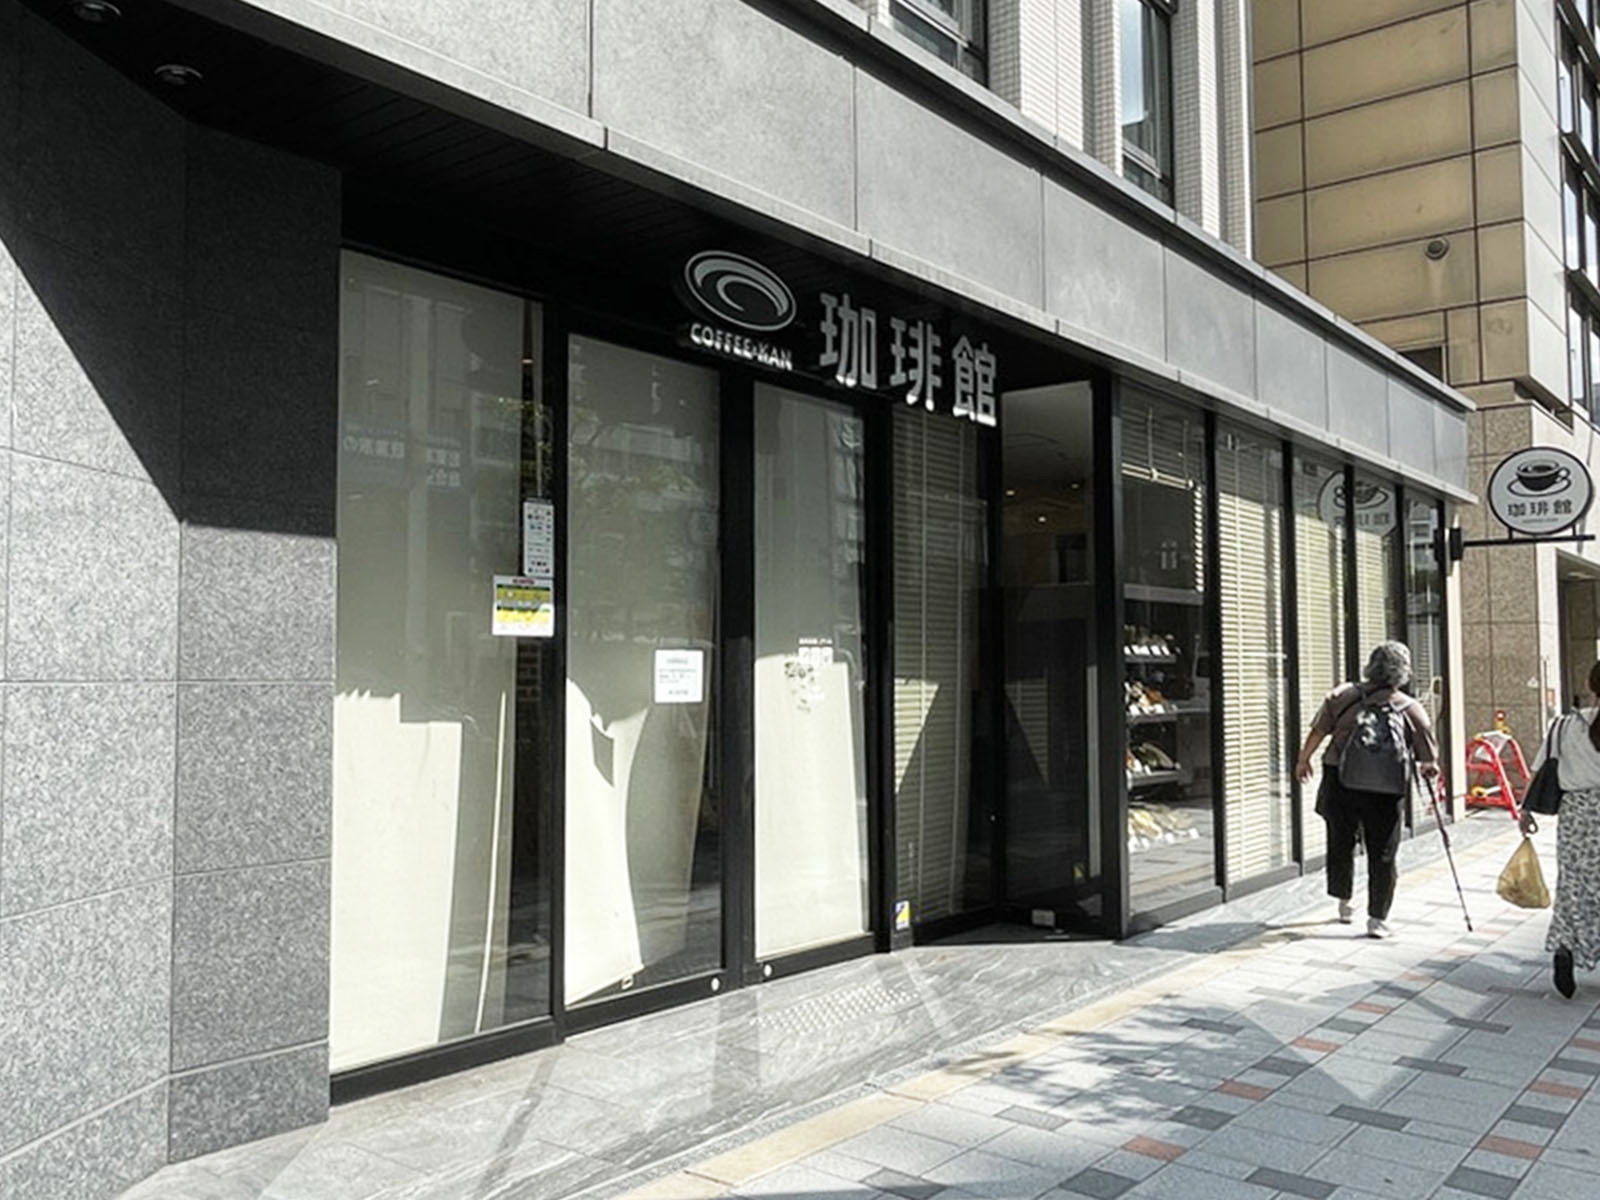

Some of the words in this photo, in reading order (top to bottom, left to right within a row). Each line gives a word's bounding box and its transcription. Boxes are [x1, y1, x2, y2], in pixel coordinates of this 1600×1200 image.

[819, 292, 998, 427] 珈琲館
[1507, 498, 1572, 517] 珈琲館
